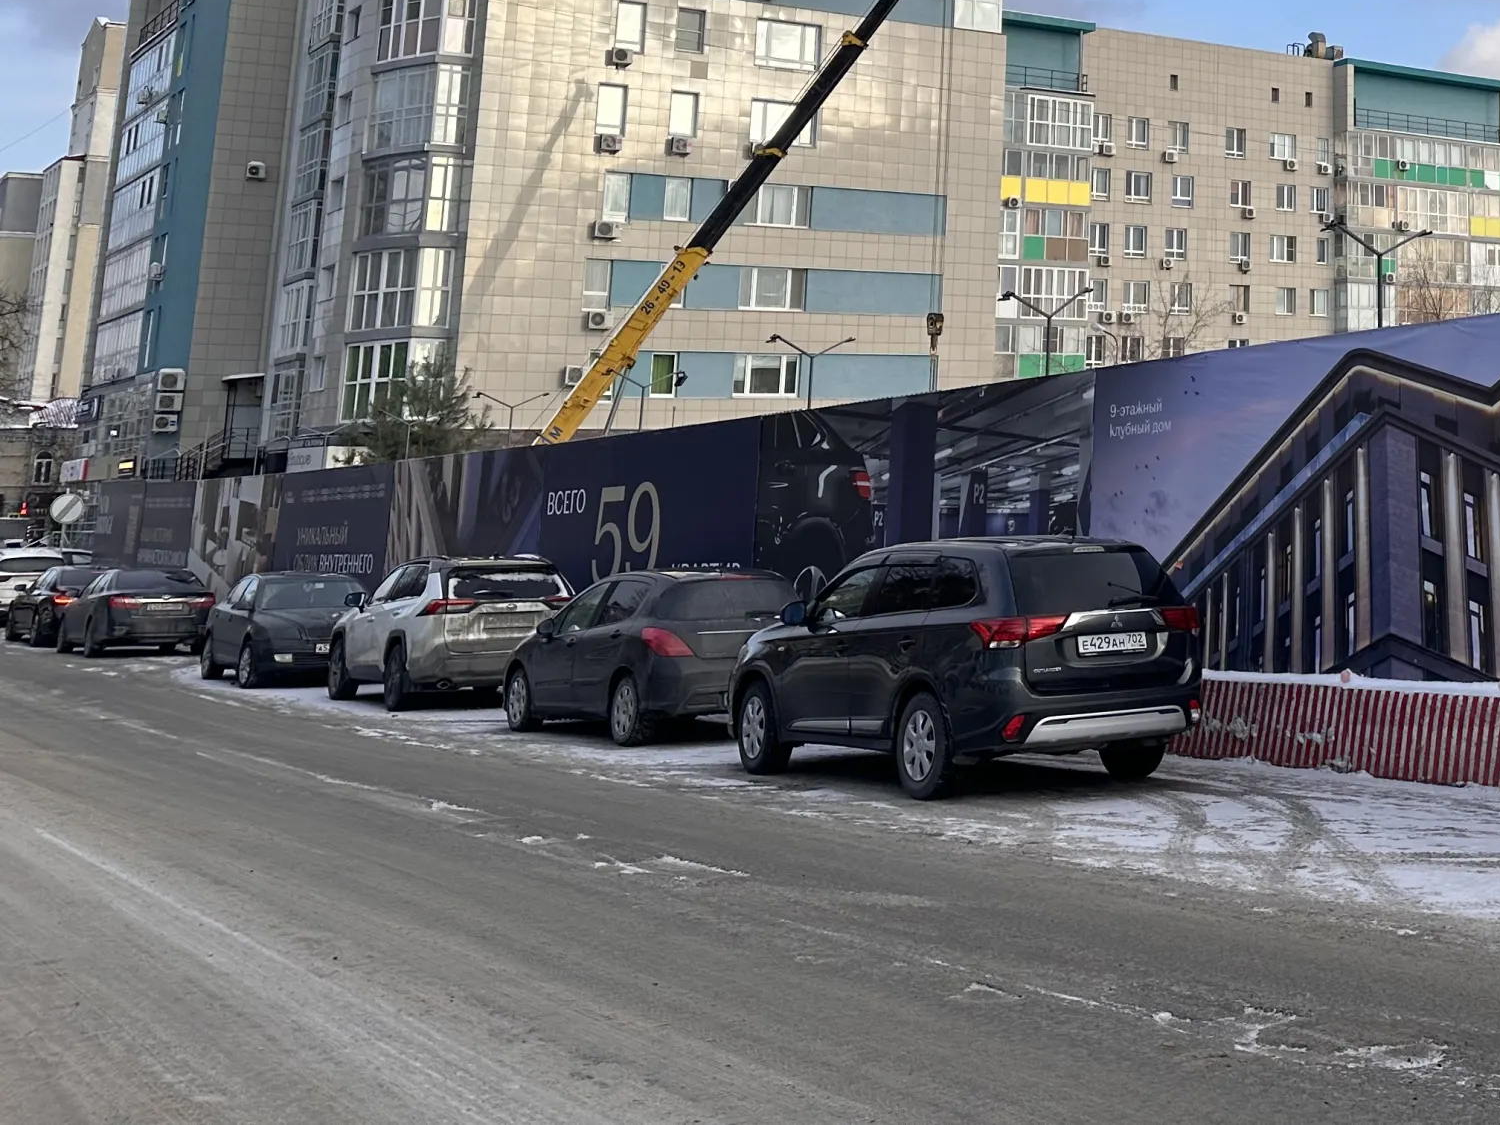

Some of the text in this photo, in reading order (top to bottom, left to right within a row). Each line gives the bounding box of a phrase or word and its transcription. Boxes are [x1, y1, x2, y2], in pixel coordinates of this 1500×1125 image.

[1110, 398, 1163, 418] 9-этажный
[1109, 419, 1172, 440] клубный дом
[547, 488, 587, 516] ВСЕГО
[591, 481, 661, 584] 59
[318, 554, 374, 575] ВНУТРЕННЕГО
